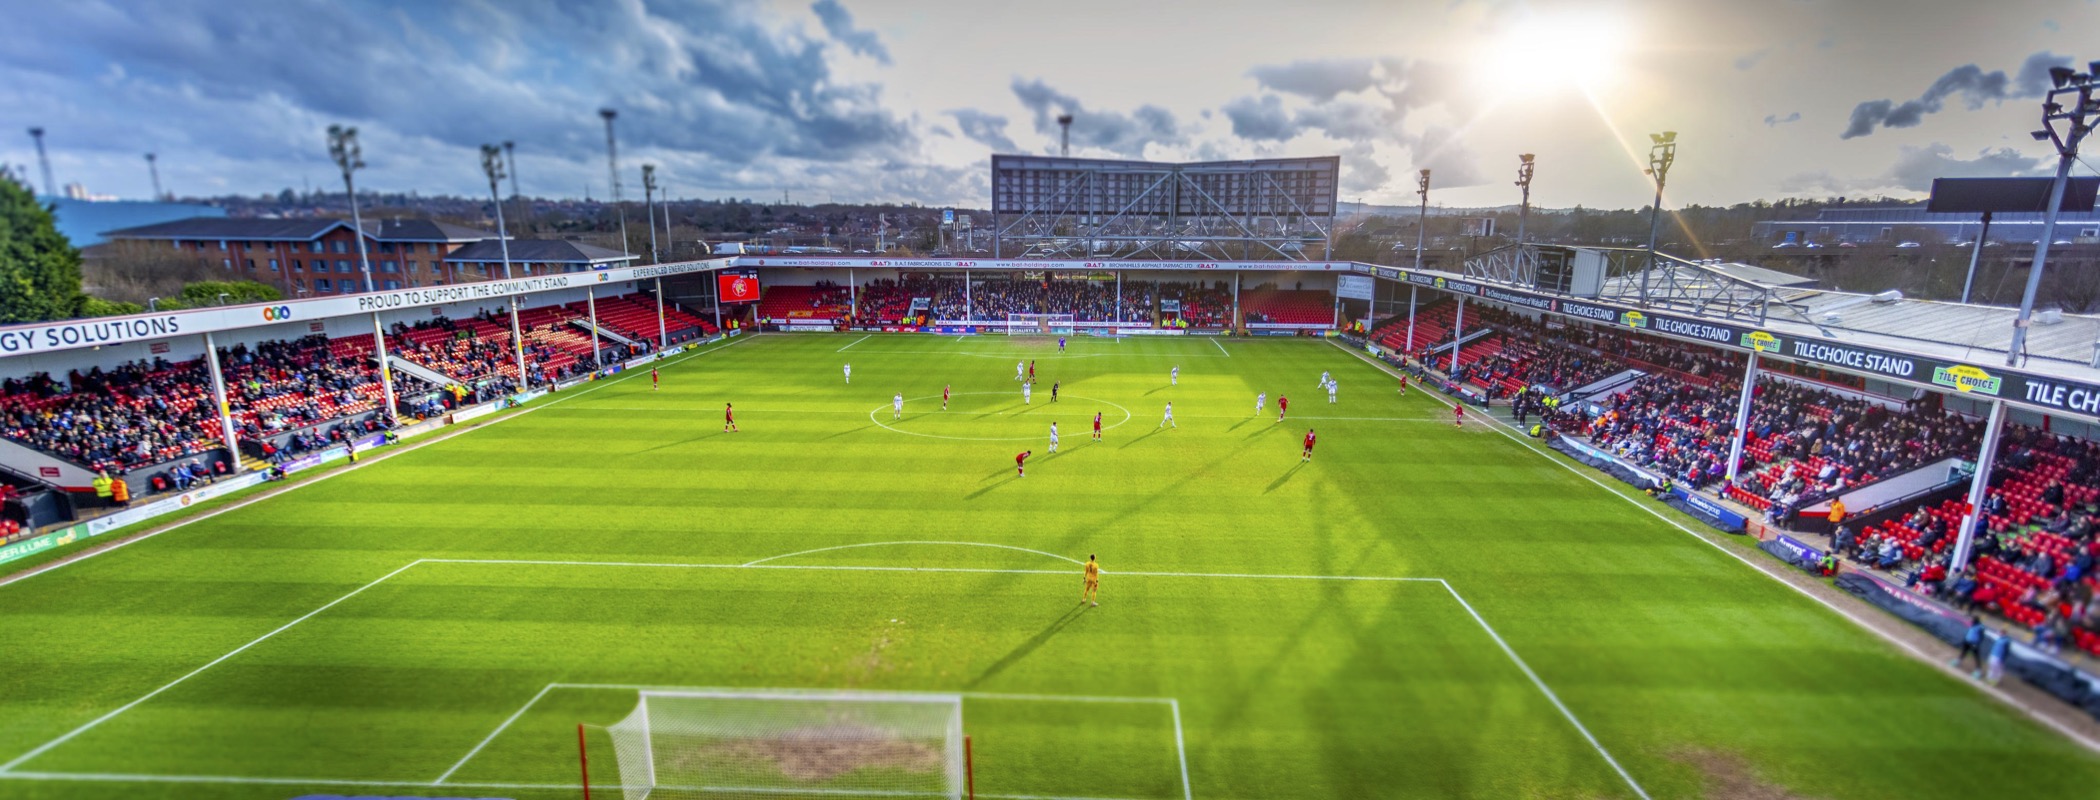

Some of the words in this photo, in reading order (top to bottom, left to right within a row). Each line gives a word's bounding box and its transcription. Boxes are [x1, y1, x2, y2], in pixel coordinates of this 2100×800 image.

[633, 266, 668, 278] EXPERIENCED
[668, 264, 686, 274] ENERGY
[686, 262, 710, 272] SOLUTIONS
[359, 293, 401, 310] PROUD
[404, 291, 421, 304] TO
[423, 286, 469, 303] SUPPORT
[472, 283, 490, 296] THE
[492, 279, 543, 295] COMMUNITY
[544, 276, 569, 288] STAND
[1562, 303, 1573, 314] TILE
[1573, 304, 1594, 318] CHOICE
[1593, 308, 1614, 321] STAND
[46, 316, 179, 347] SOLUTIONS
[1655, 317, 1671, 331] TILE
[1670, 320, 1700, 337] CHOICE
[1700, 326, 1731, 342] STAND
[1794, 341, 1818, 358] TILE
[1816, 345, 1863, 368] CHOICE
[1864, 354, 1913, 376] STAND
[1939, 372, 1958, 383] TILE
[1960, 375, 1994, 389] CHOICE
[2025, 381, 2067, 407] TILE
